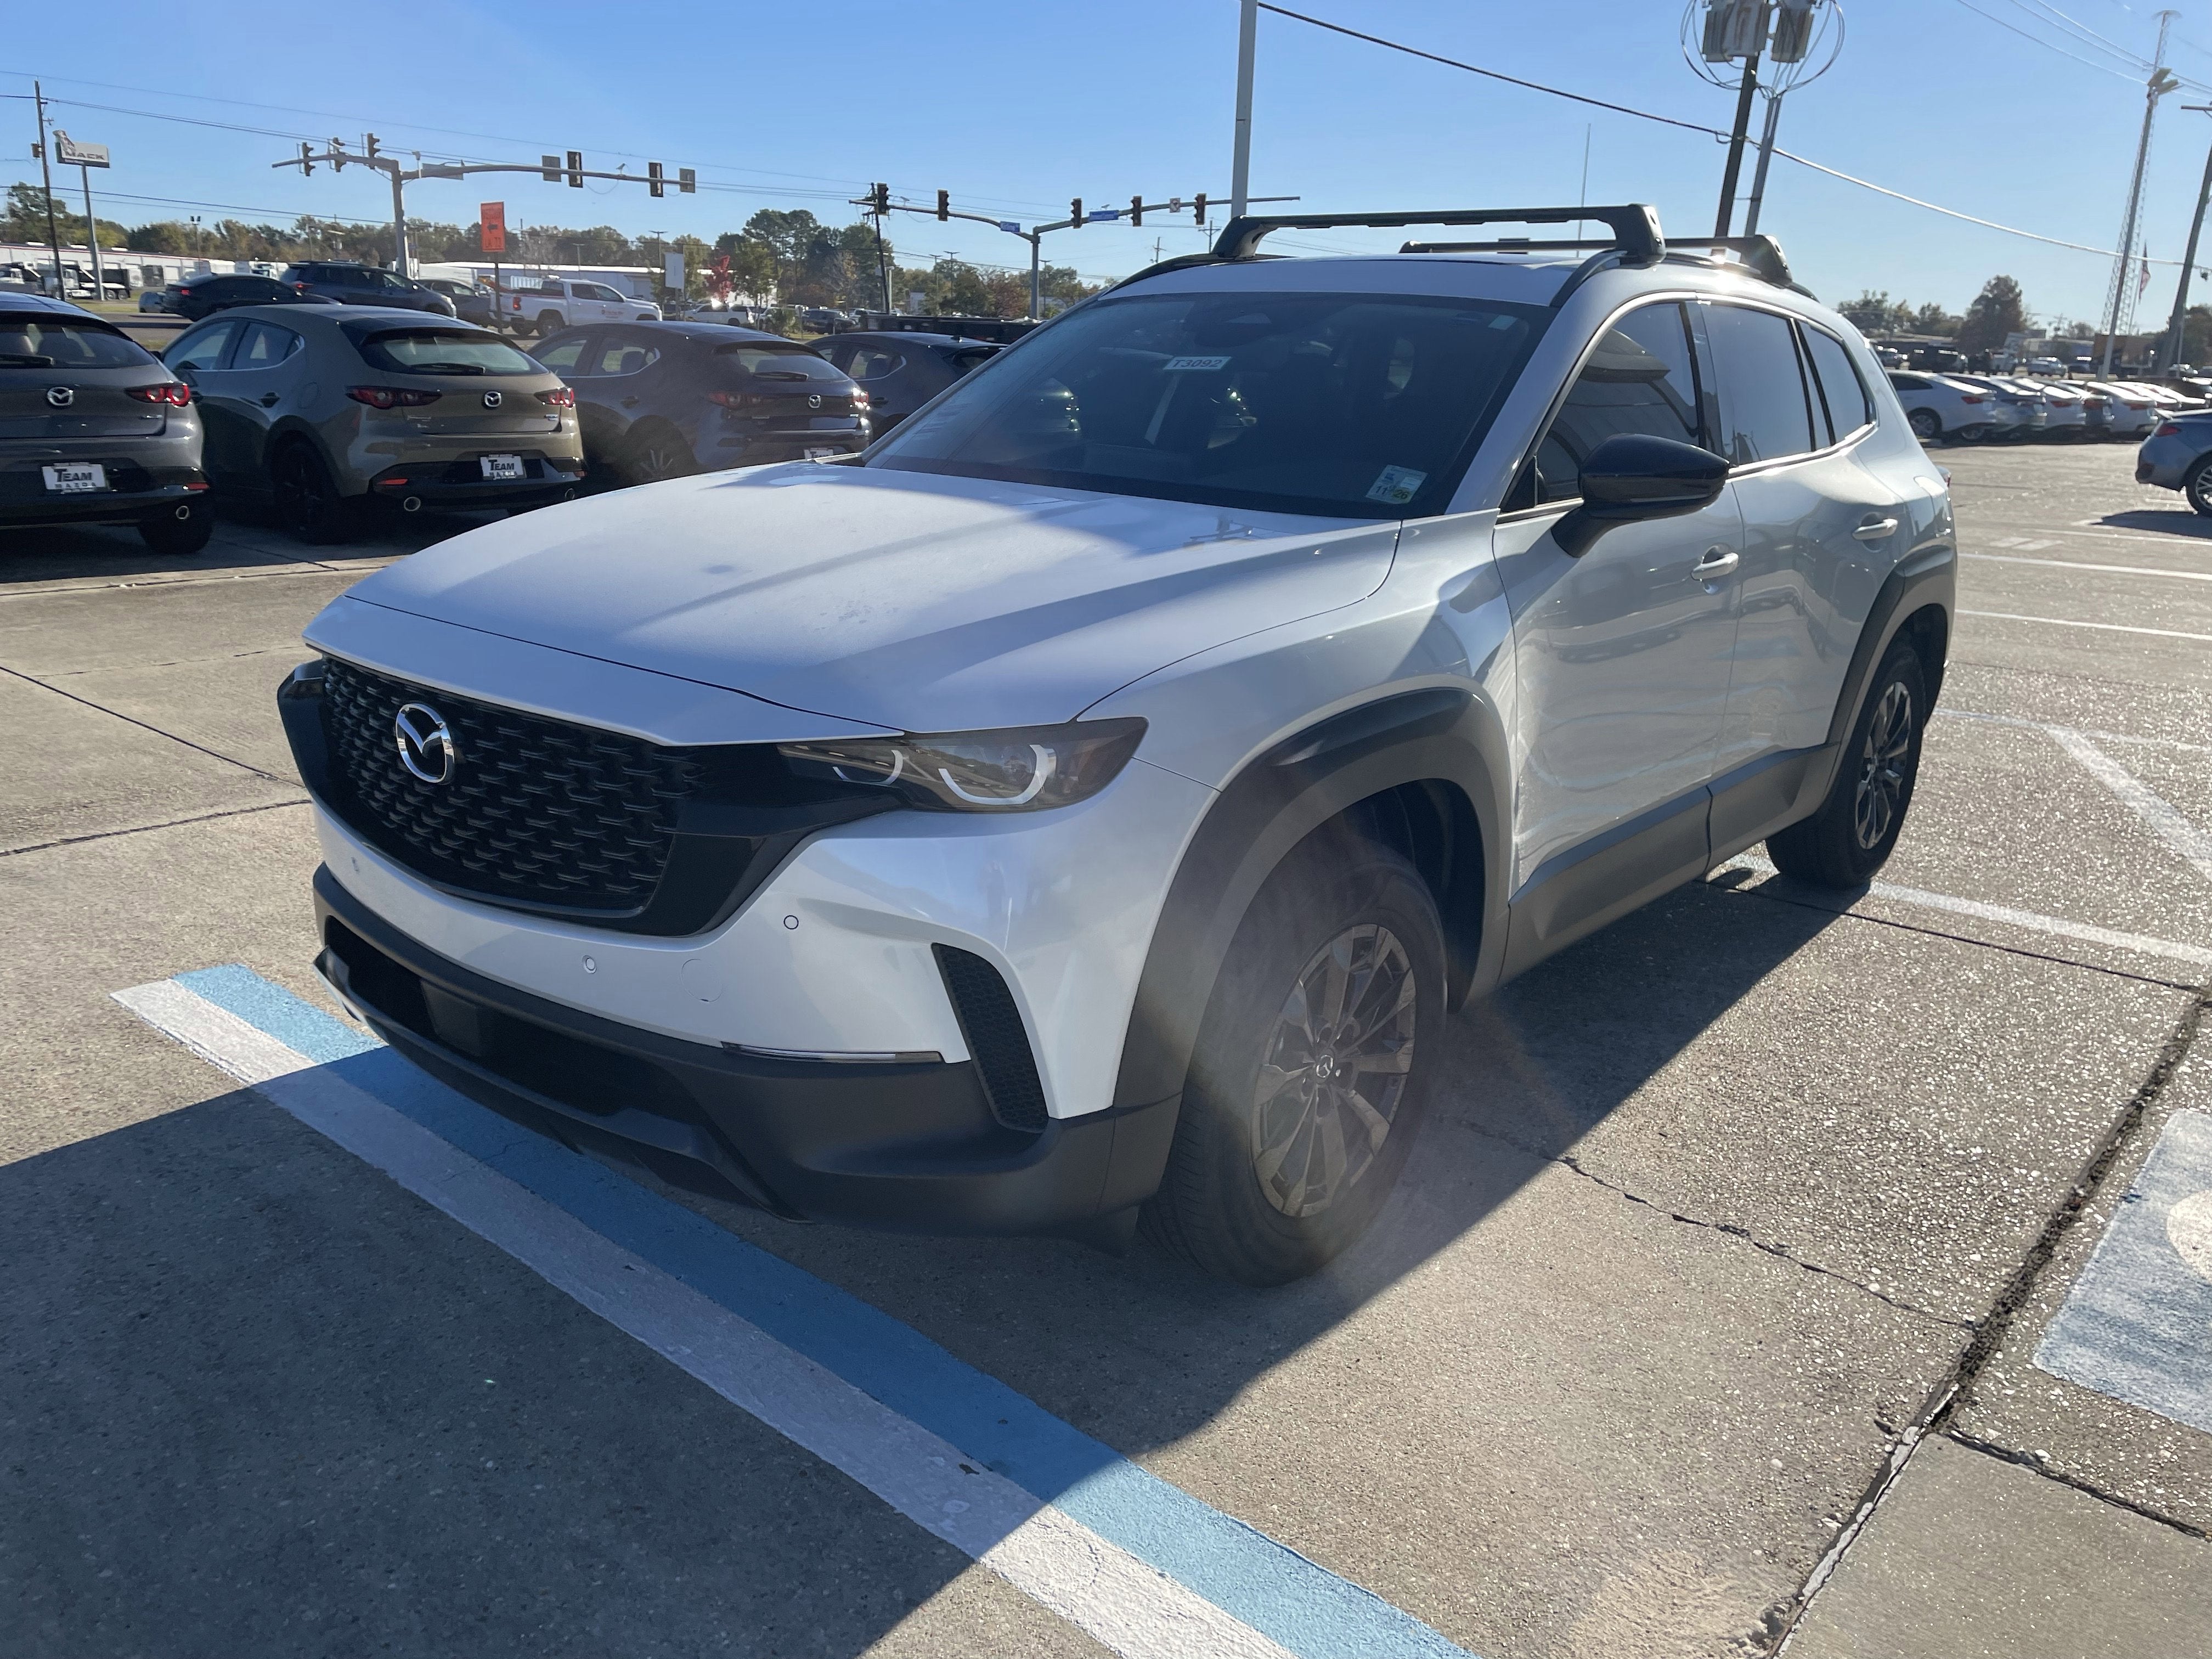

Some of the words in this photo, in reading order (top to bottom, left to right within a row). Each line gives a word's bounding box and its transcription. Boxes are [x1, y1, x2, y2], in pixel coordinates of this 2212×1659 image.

[65, 151, 104, 160] MACK
[1172, 359, 1222, 368] T3092
[488, 459, 515, 470] TEAM
[54, 468, 92, 482] TEAM
[1375, 486, 1388, 495] 11
[1393, 489, 1410, 499] 26
